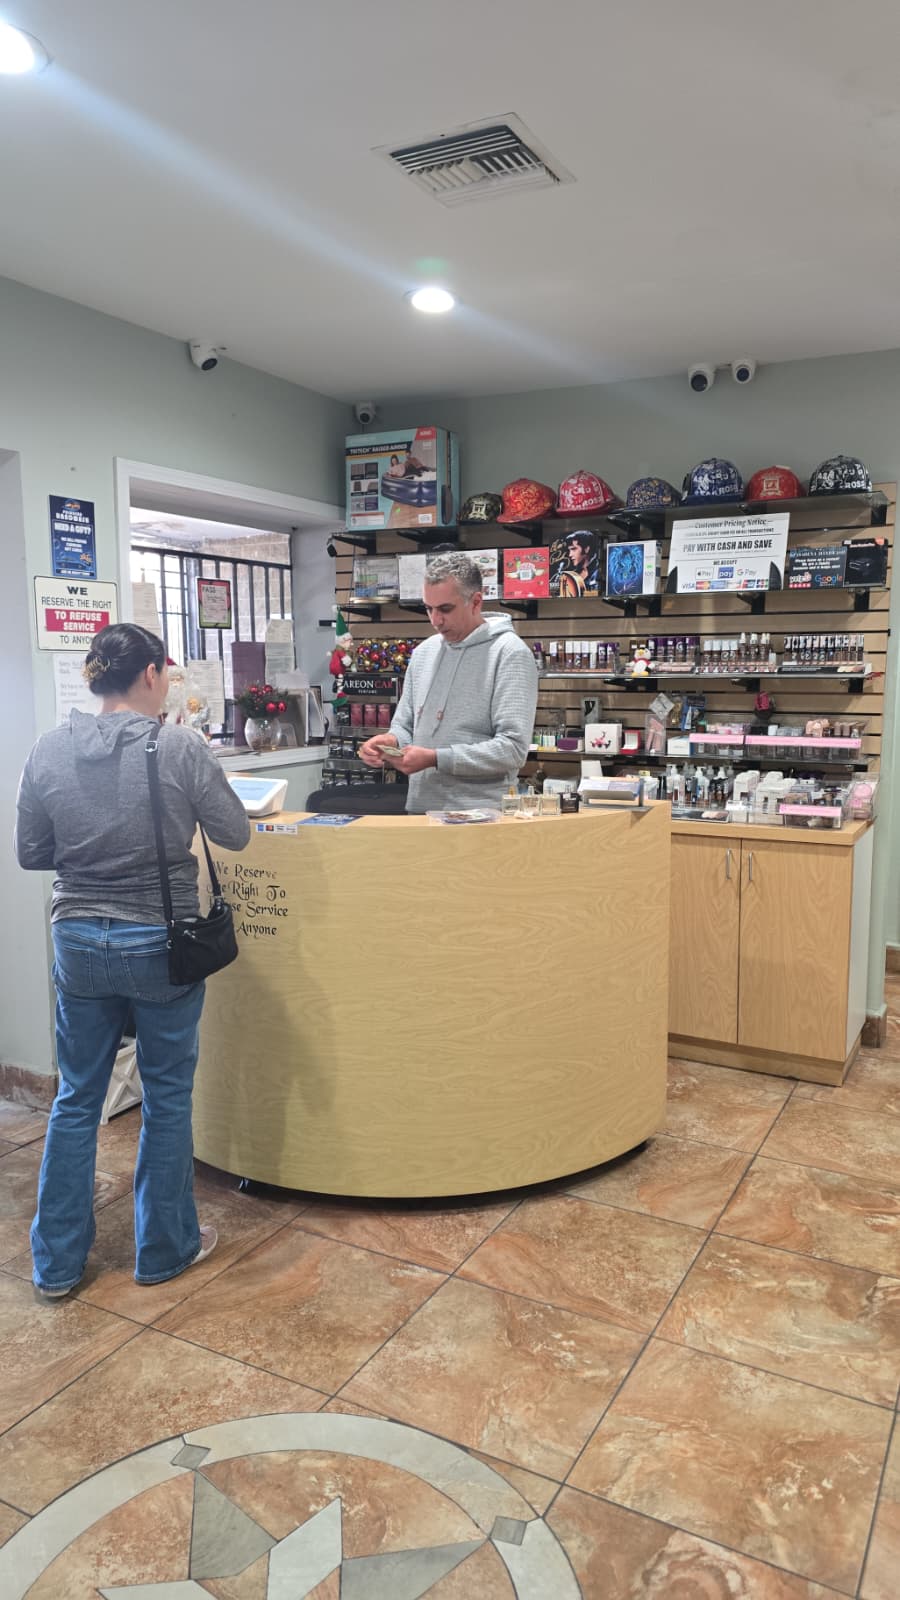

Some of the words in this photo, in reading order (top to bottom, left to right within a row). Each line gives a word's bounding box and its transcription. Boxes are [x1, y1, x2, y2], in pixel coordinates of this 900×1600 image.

[694, 521, 723, 529] Customer
[724, 519, 746, 528] Pricing
[747, 518, 767, 526] Notice
[683, 544, 696, 553] PAY
[696, 543, 715, 552] WITH
[716, 541, 736, 551] CASH
[737, 540, 752, 550] AND
[753, 539, 773, 549] SAVE
[815, 573, 843, 583] Google
[67, 586, 88, 596] WE
[41, 596, 74, 608] RESERVE
[76, 598, 90, 608] THE
[92, 600, 112, 609] RIGHT
[54, 610, 66, 621] TO
[69, 611, 102, 622] REFUSE
[63, 622, 95, 632] SERVICE
[59, 635, 69, 644] TO
[72, 636, 92, 645] ANYO
[343, 680, 374, 689] AREON
[374, 680, 393, 689] CAR
[212, 861, 229, 875] We
[235, 863, 278, 883] Reserve
[228, 881, 259, 901] Right
[266, 885, 286, 902] To
[245, 901, 289, 918] Service
[237, 921, 278, 940] Anyone
